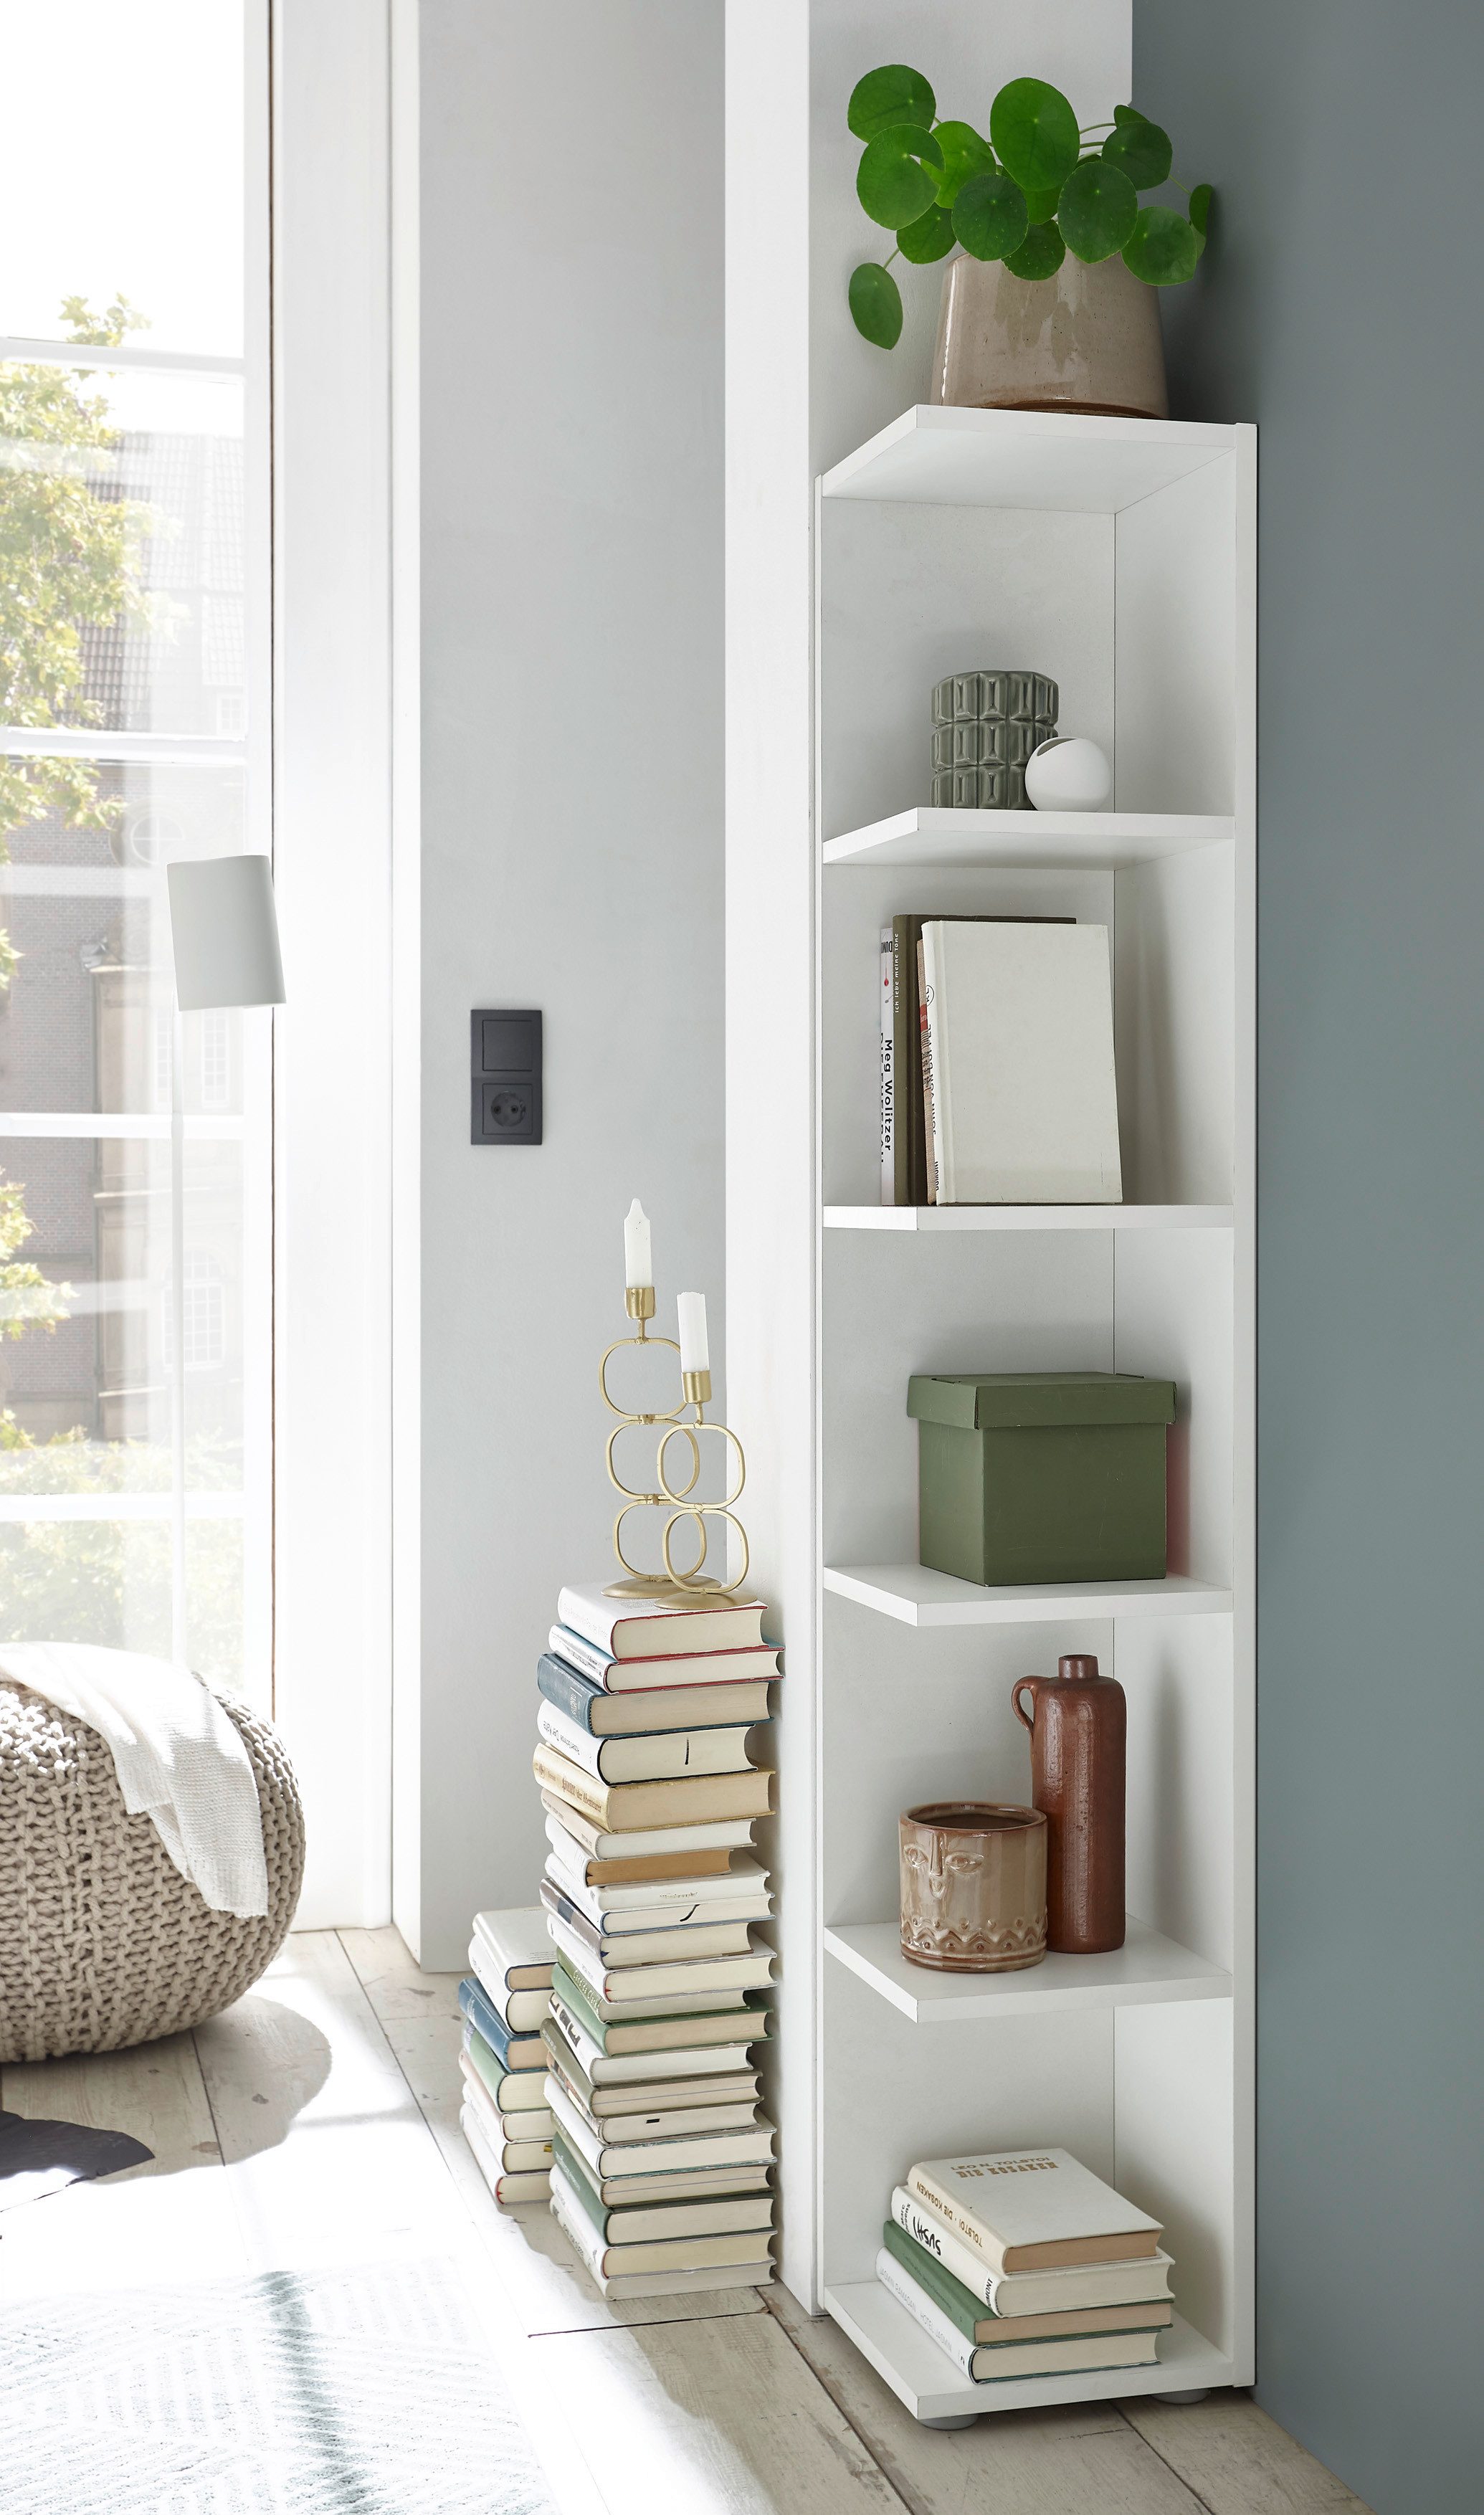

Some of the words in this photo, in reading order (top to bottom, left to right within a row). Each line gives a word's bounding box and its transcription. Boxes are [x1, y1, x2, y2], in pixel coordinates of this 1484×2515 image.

[883, 1040, 893, 1073] Meg
[885, 1079, 893, 1151] Wolitzer
[573, 1969, 588, 1995] Candida
[956, 2169, 984, 2179] DIE
[986, 2162, 1060, 2175] KOSAKEN
[994, 2157, 1050, 2166] TOLSTOI
[916, 2181, 944, 2212] KOSAKEN
[943, 2205, 953, 2221] DIE
[913, 2216, 941, 2256] SUSHI
[959, 2217, 984, 2248] TOLSTOI
